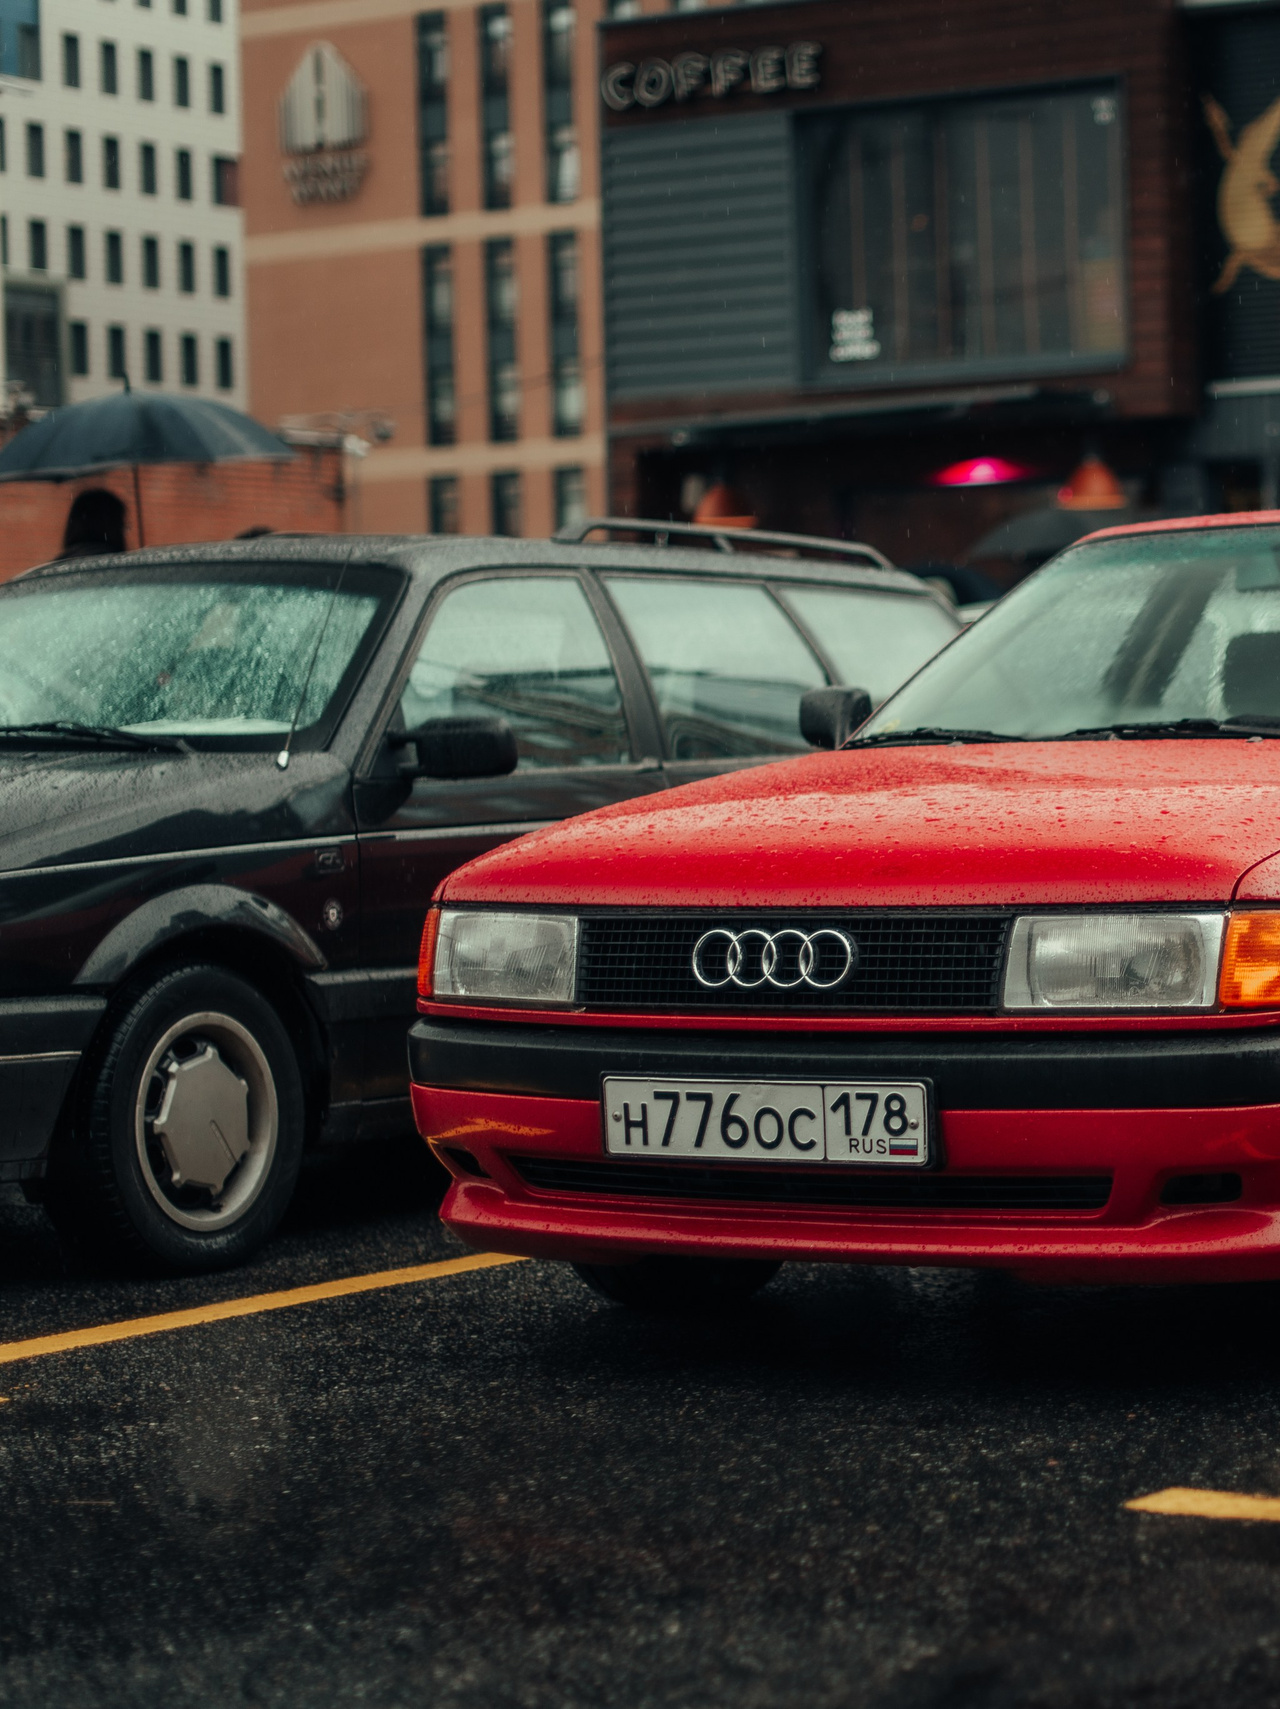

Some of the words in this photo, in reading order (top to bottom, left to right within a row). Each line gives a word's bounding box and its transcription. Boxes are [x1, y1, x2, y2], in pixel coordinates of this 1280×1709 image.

[601, 41, 823, 111] COFFEE
[829, 1090, 908, 1137] 178
[848, 1138, 888, 1155] RUS
